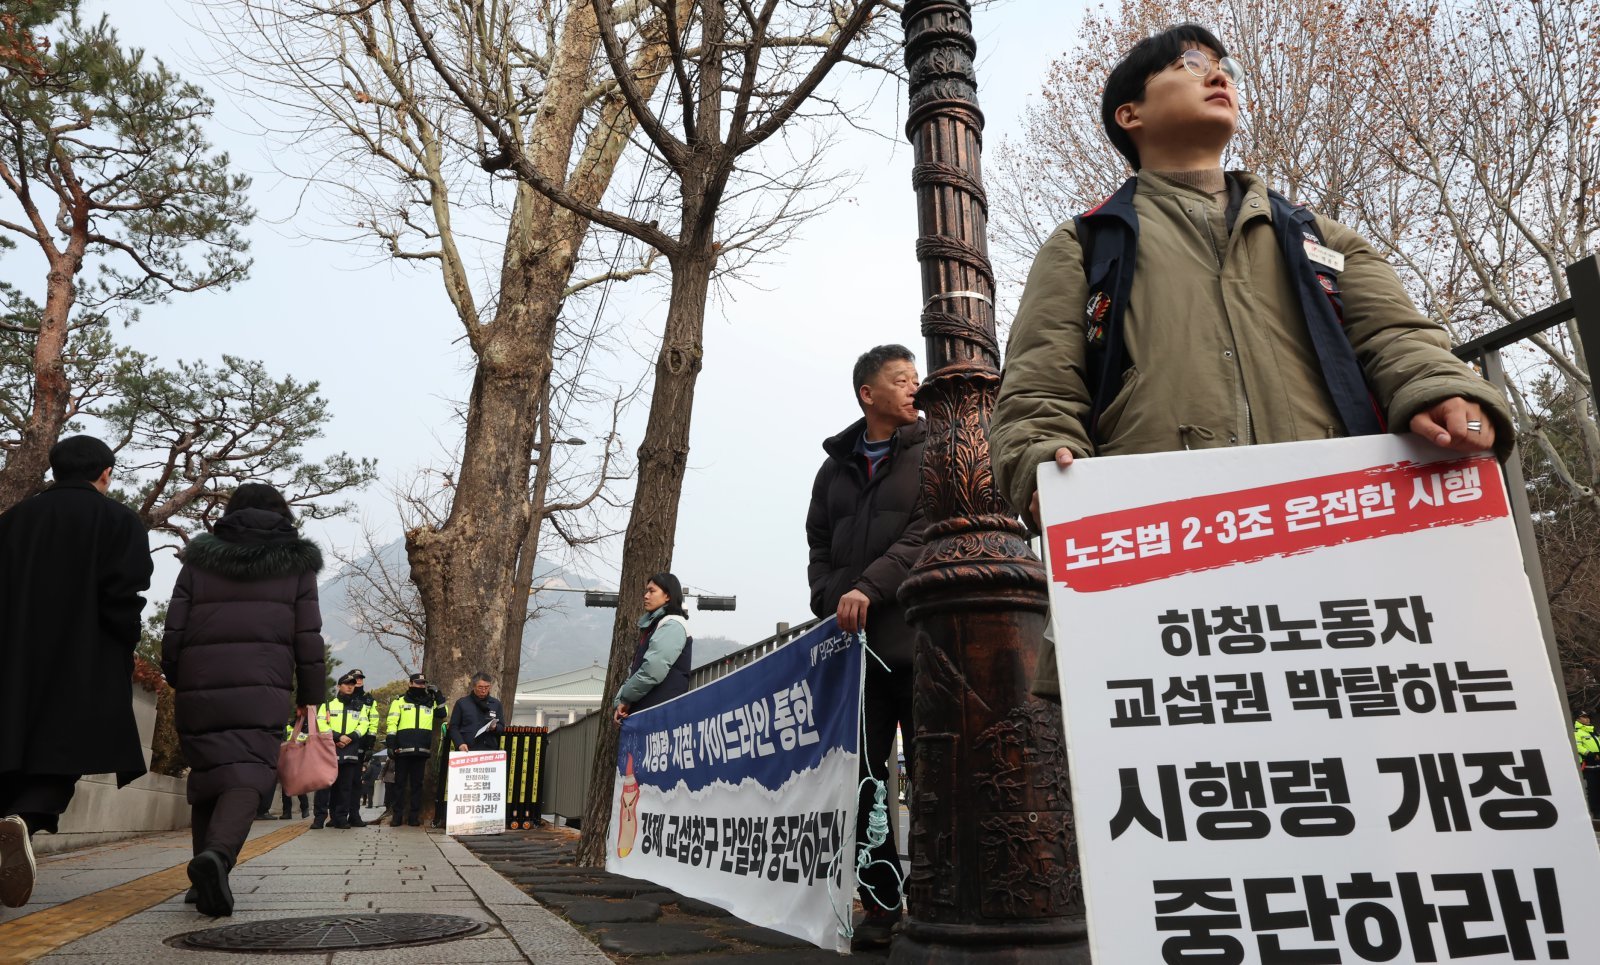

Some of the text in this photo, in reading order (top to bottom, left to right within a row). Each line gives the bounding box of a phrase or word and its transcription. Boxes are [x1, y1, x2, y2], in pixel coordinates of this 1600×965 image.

[1066, 467, 1483, 570] 노조법 2·3조 온전한 시행
[1158, 596, 1433, 656] 하청노동자
[773, 679, 820, 751] 통한
[1107, 662, 1517, 727] 교섭권 박탈하는
[455, 804, 498, 815] 폐기하라!
[464, 782, 491, 791] 노조법
[483, 793, 501, 802] 개정
[1110, 749, 1558, 841] 시행령 개정
[641, 812, 665, 857] 강제
[665, 815, 719, 869] 교섭창구
[720, 816, 769, 878] 단일화
[1153, 868, 1569, 965] 중단하라!
